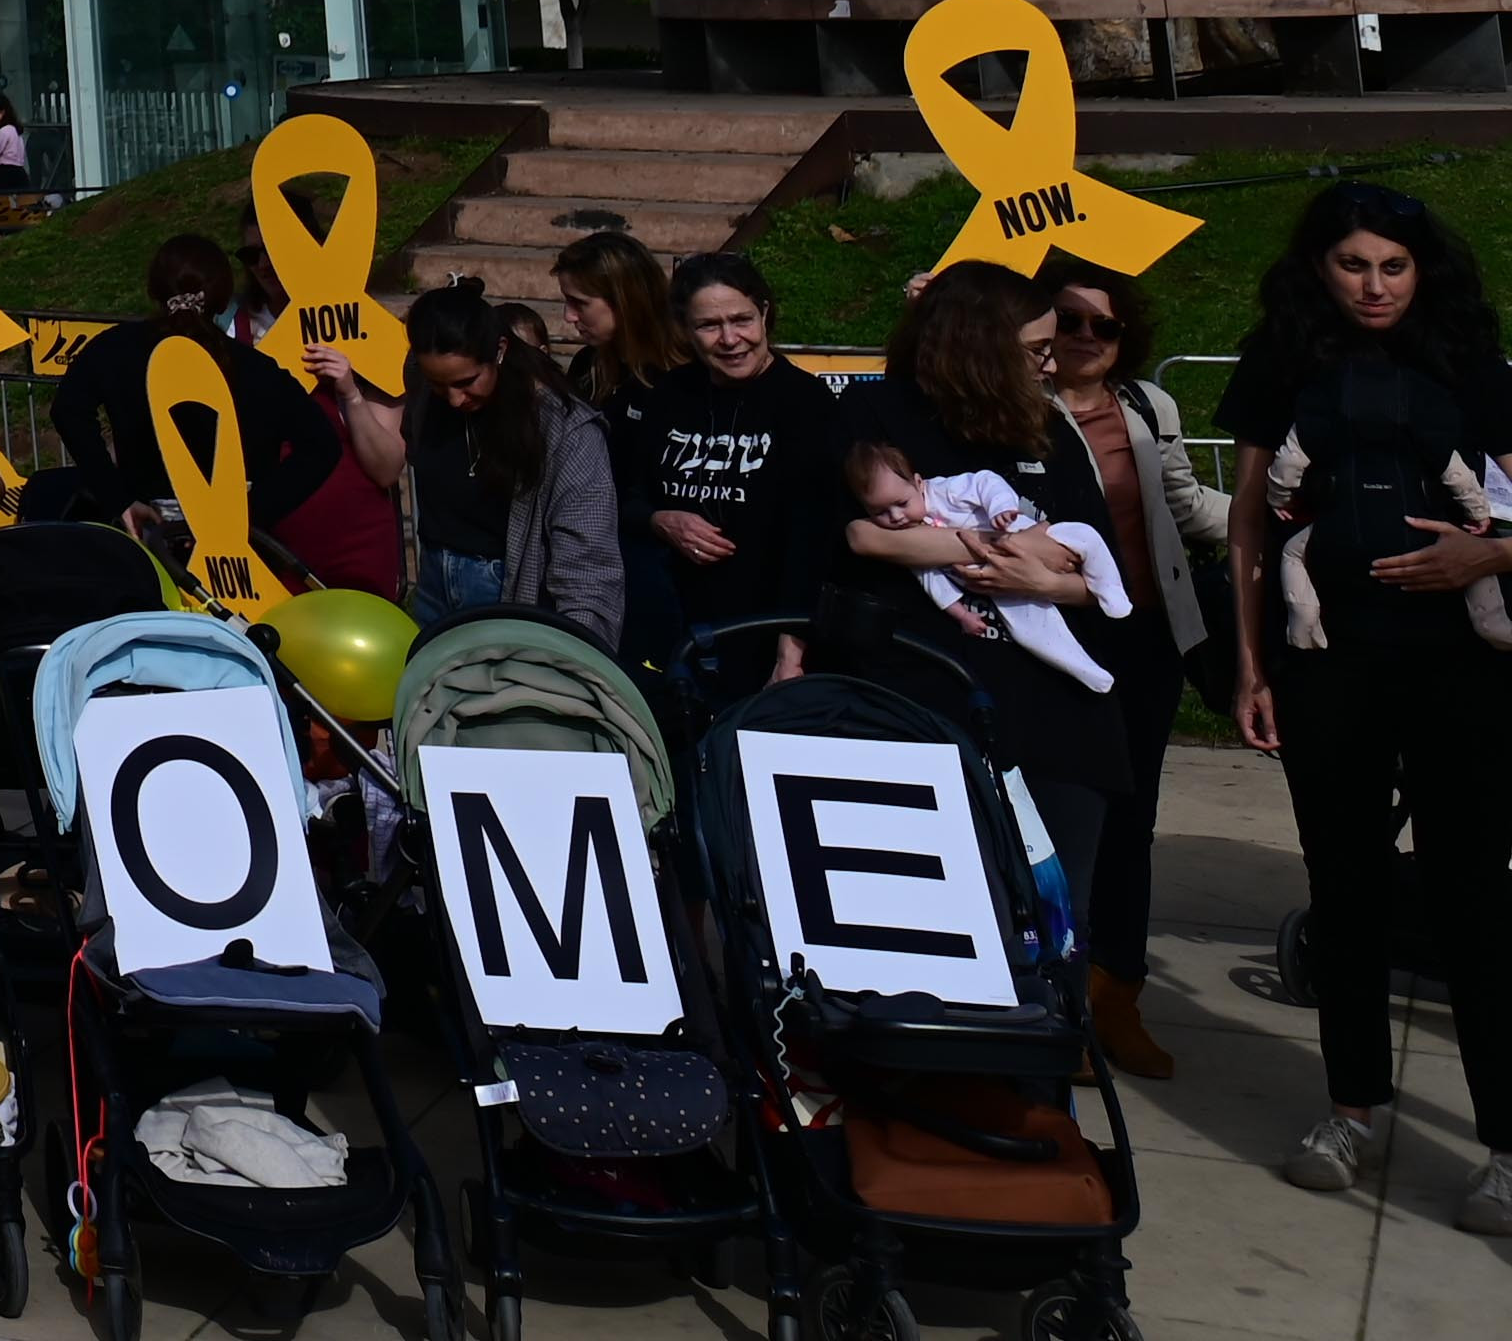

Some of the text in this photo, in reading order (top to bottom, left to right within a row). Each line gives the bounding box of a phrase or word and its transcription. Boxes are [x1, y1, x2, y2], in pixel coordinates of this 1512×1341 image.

[995, 183, 1087, 240] NOW.
[300, 303, 368, 344] NOW.
[661, 481, 747, 504] באוקטובר
[205, 556, 260, 601] NOW.
